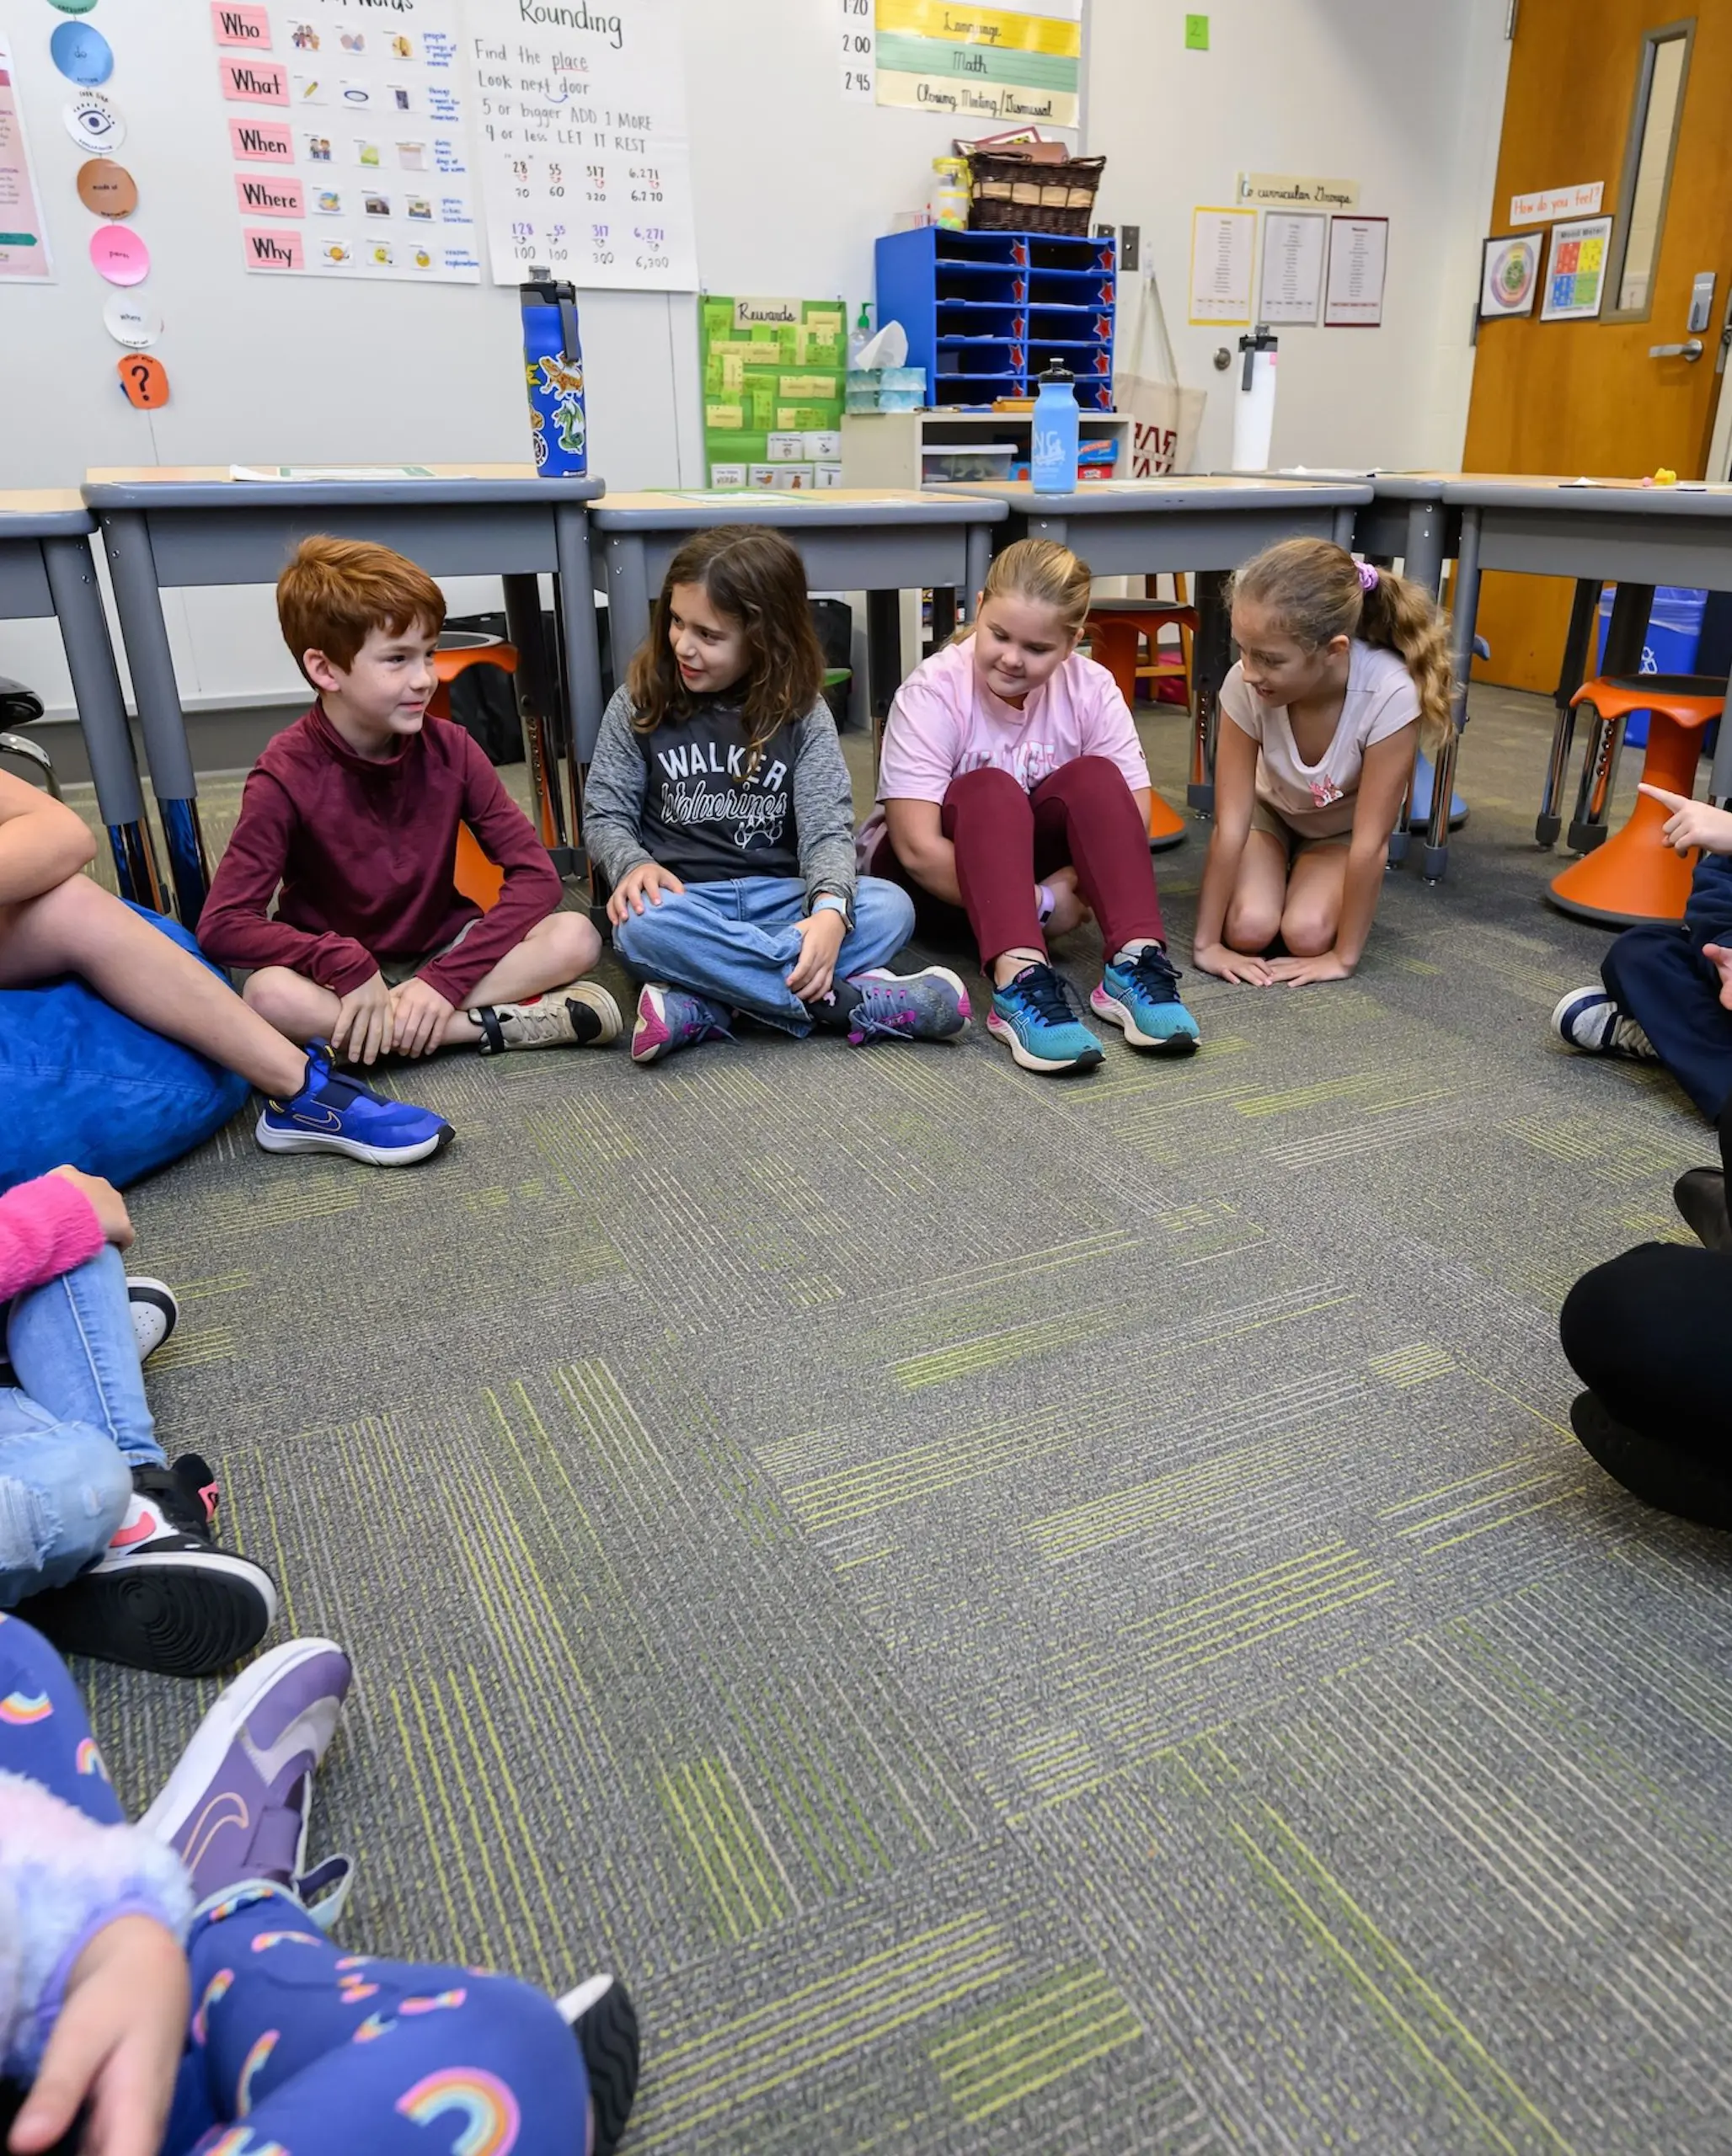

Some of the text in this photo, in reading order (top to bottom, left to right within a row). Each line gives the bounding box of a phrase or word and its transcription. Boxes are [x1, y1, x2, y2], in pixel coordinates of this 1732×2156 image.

[220, 12, 259, 38] Who
[519, 0, 623, 49] Rounding
[474, 39, 588, 74] Find the place
[954, 51, 988, 74] Math
[231, 67, 281, 94] What
[478, 70, 591, 94] Look next door
[917, 83, 958, 112] Closing
[483, 99, 653, 131] 5 or bigger ADD 1 MORE
[238, 128, 287, 153] When
[485, 125, 646, 153] 4 or less LET IT REST
[513, 161, 527, 173] 28
[549, 163, 562, 175] 55
[243, 183, 297, 208] Where
[549, 186, 564, 197] 60
[1516, 200, 1533, 215] How
[1537, 195, 1548, 211] do
[1551, 199, 1568, 214] you
[512, 222, 533, 236] 128
[553, 224, 566, 236] 55
[592, 224, 609, 237] 317
[253, 237, 291, 267] Why
[515, 246, 536, 260] 100
[549, 248, 568, 261] 100
[593, 252, 614, 264] 300
[737, 302, 796, 323] Rewards
[131, 365, 149, 401] ?
[657, 742, 788, 792] WALKER
[660, 780, 788, 825] Wolverines
